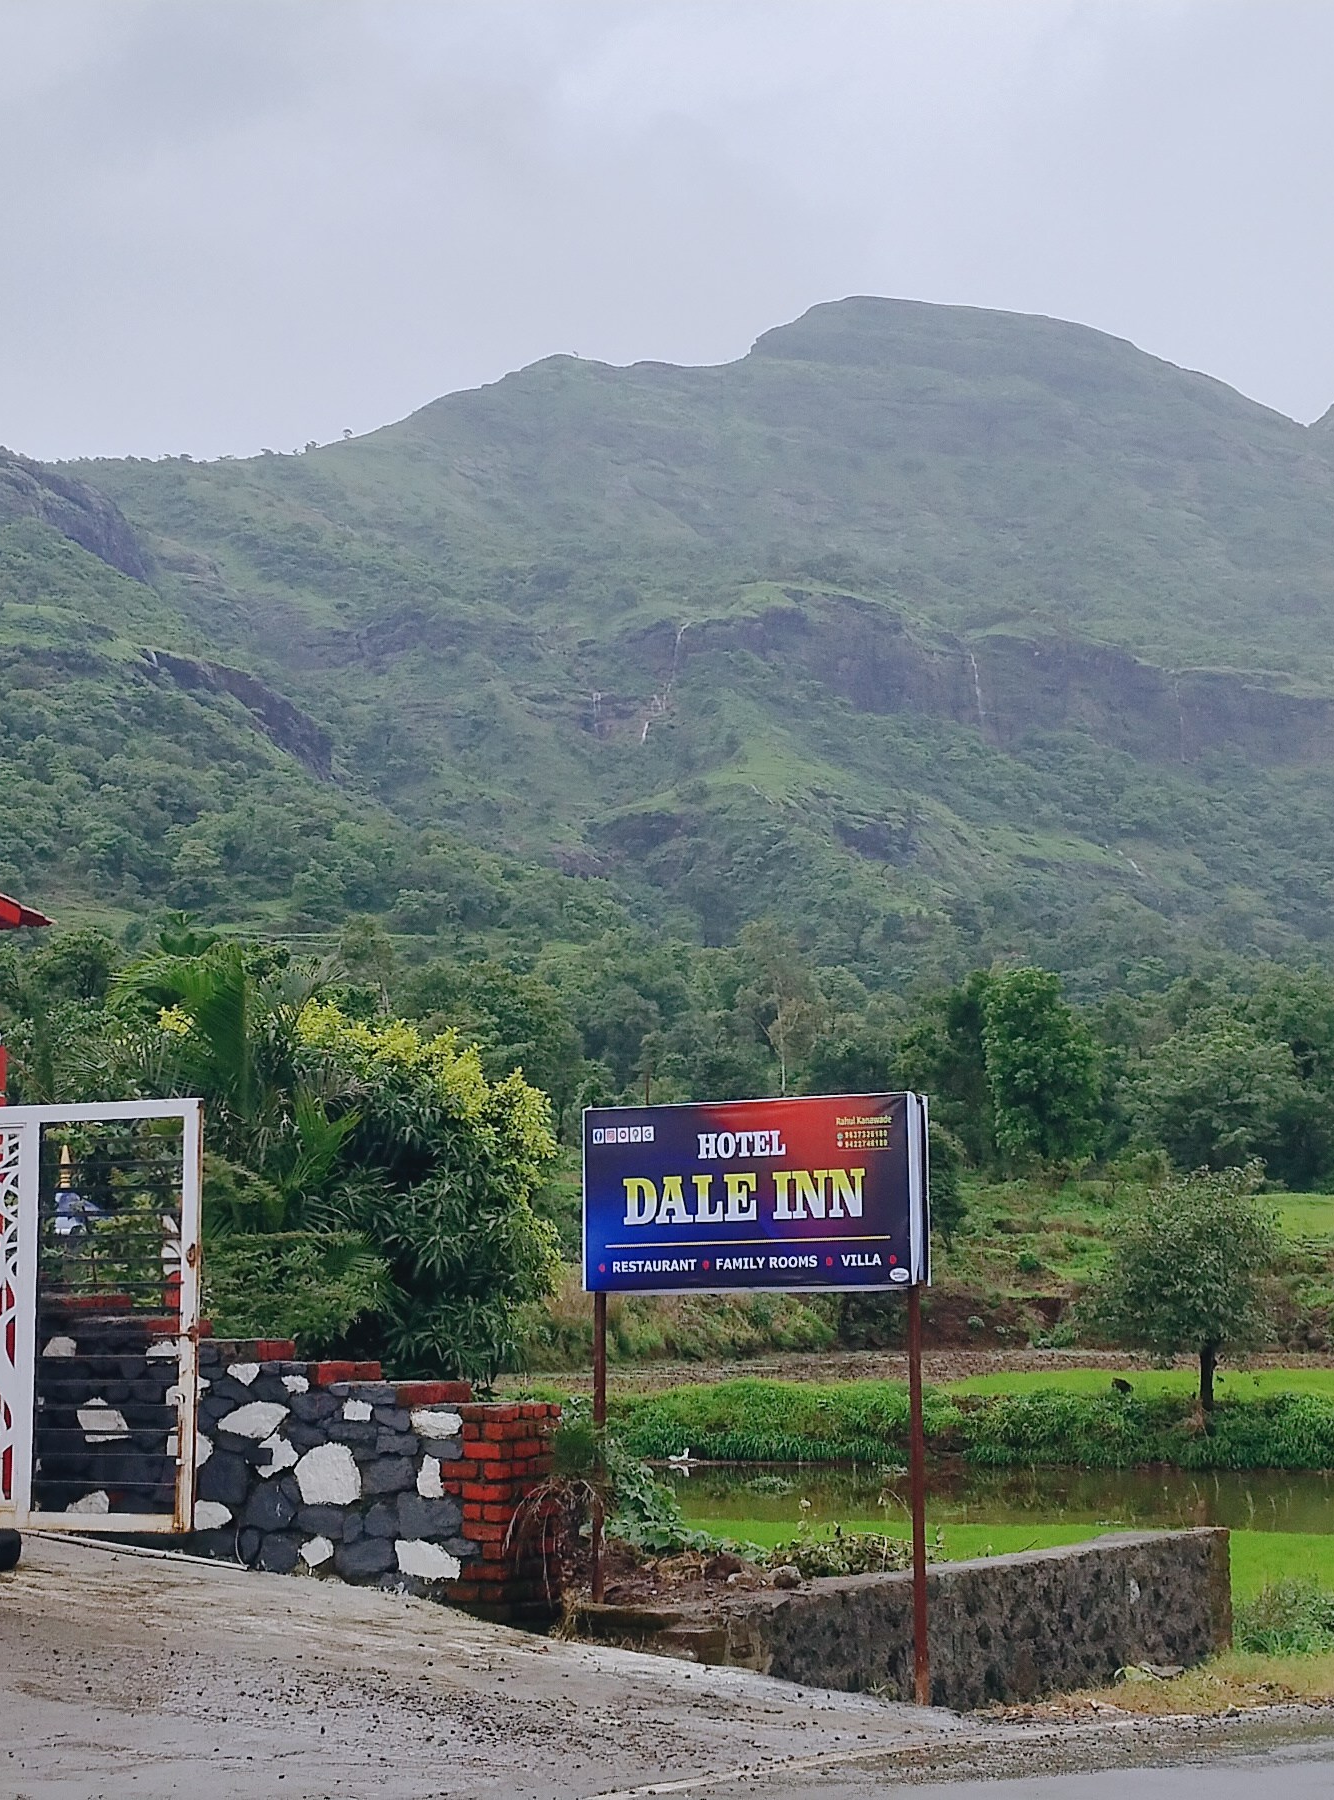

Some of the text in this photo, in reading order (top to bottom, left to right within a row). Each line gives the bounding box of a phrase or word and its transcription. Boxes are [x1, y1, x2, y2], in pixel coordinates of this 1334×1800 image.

[697, 1130, 786, 1159] HOTEL
[623, 1168, 865, 1226] DALE INN
[612, 1254, 882, 1273] RESTAURANT FAMILY ROOMS VILLA
